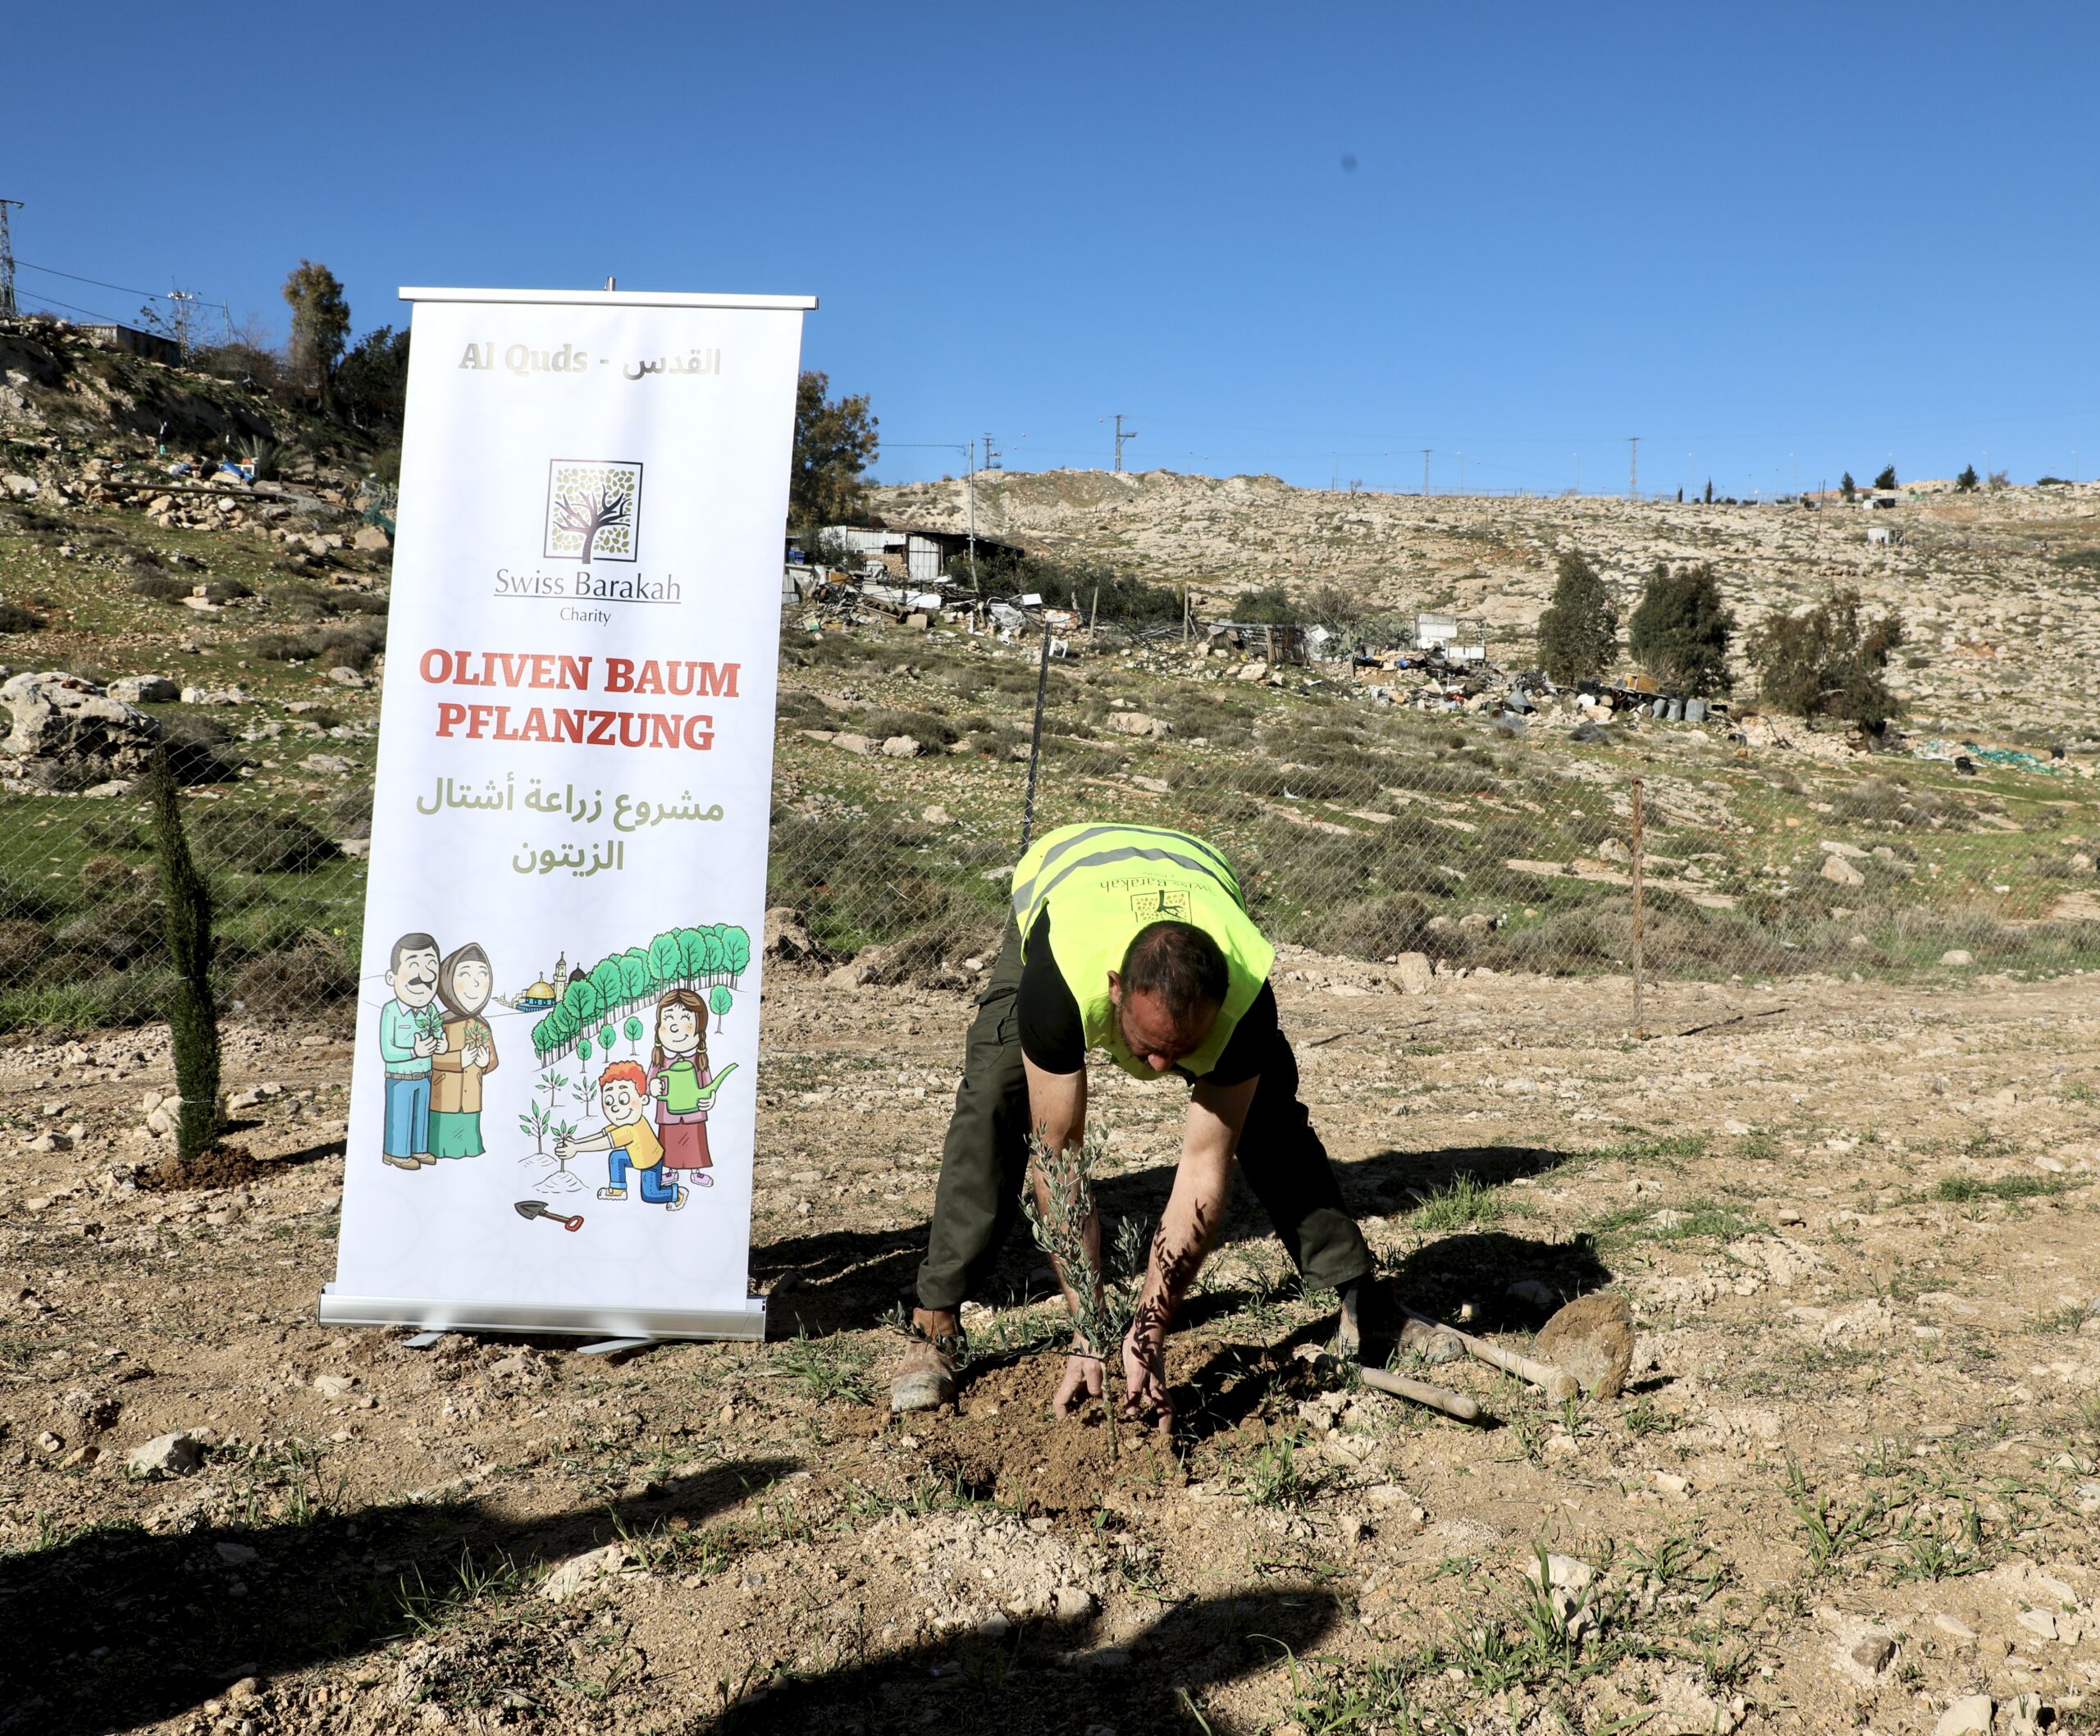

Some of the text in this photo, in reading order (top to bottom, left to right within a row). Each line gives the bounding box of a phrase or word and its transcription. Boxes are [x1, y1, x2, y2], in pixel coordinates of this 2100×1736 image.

[459, 343, 494, 369] Al
[504, 344, 588, 377] Quds
[623, 349, 721, 380] القدس
[494, 569, 681, 601] Swiss Barakah
[559, 607, 612, 627] Charity
[419, 648, 741, 697] OLIVEN BAUM
[436, 702, 714, 751] PFLANZUNG
[416, 771, 724, 832] مشروع زراعة أشتال
[512, 839, 624, 877] الزيتون
[1100, 878, 1166, 893] Barakah
